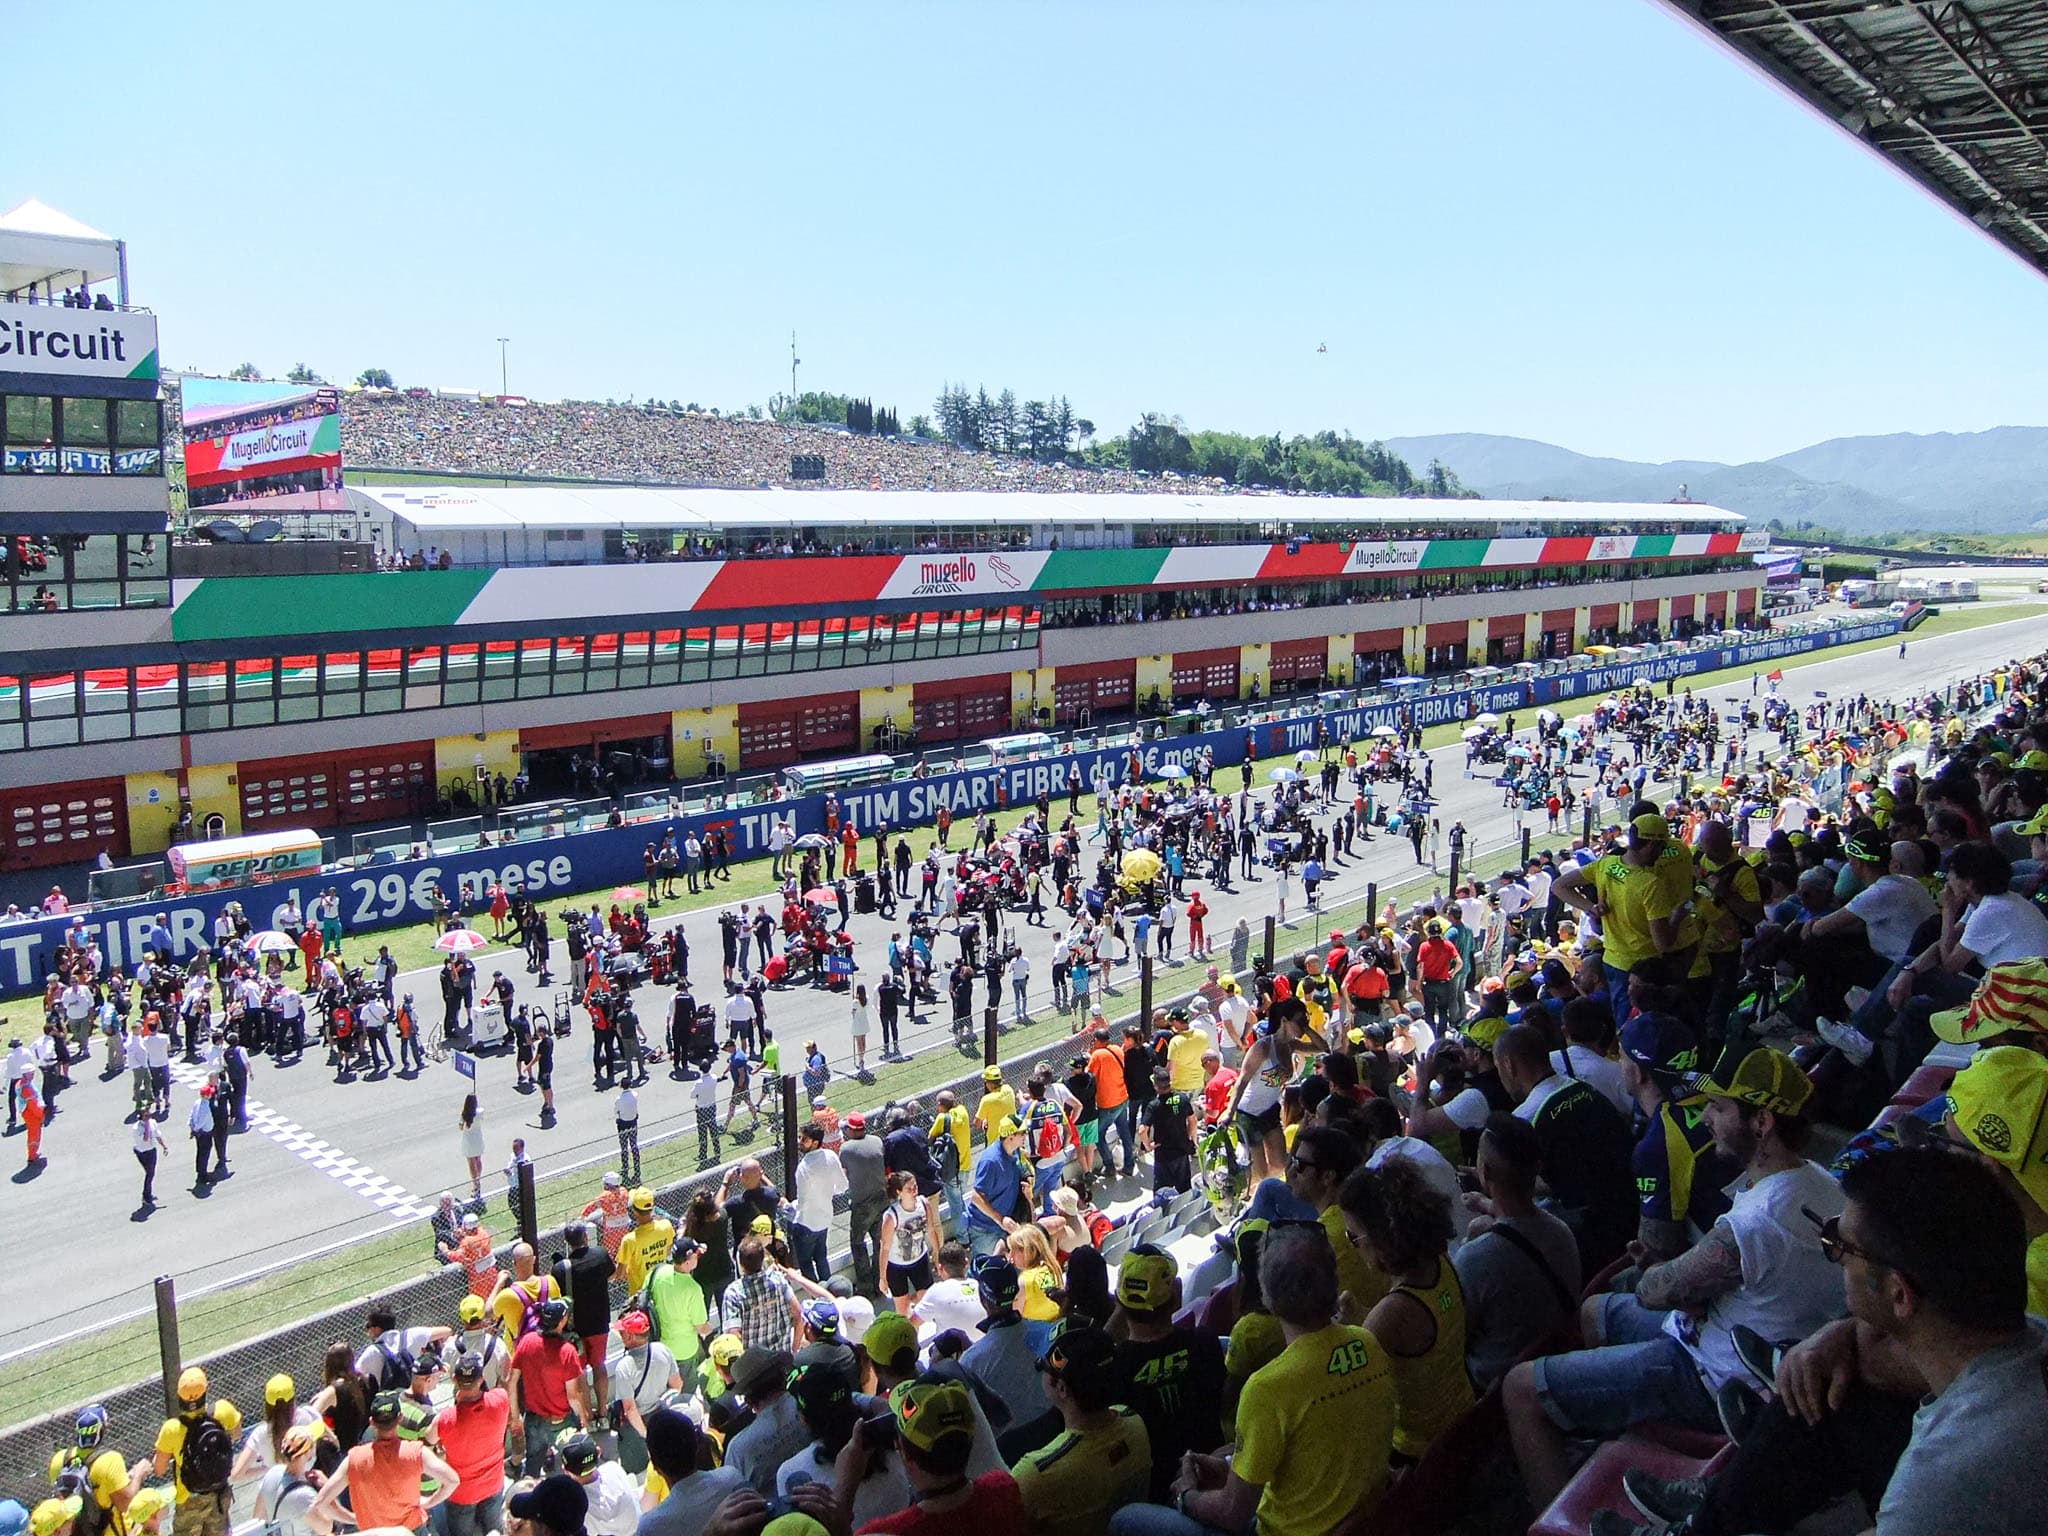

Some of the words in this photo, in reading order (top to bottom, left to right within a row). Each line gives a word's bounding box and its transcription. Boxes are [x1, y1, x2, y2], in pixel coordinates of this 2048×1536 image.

[231, 429, 308, 461] MugelloCircuit
[921, 556, 976, 584] mugello
[1355, 547, 1418, 569] MugelloCircuit
[1559, 677, 1575, 696] TIM
[1586, 671, 1601, 692] TIM
[1334, 712, 1361, 740] TIM
[1415, 698, 1451, 724] FIBRA
[1492, 690, 1520, 709] mese
[1286, 722, 1313, 748] TIM
[844, 790, 899, 830] TIM
[908, 773, 1000, 820] SMART
[1012, 759, 1084, 801] FIBRA
[1089, 755, 1116, 784] da
[1751, 807, 1771, 819] 46
[740, 809, 798, 850] TIM
[211, 853, 300, 878] REPSOL
[350, 866, 443, 924] 29€
[458, 854, 572, 906] mese
[838, 960, 851, 971] TIM
[1134, 1347, 1189, 1385] 46
[1327, 1339, 1369, 1376] 46
